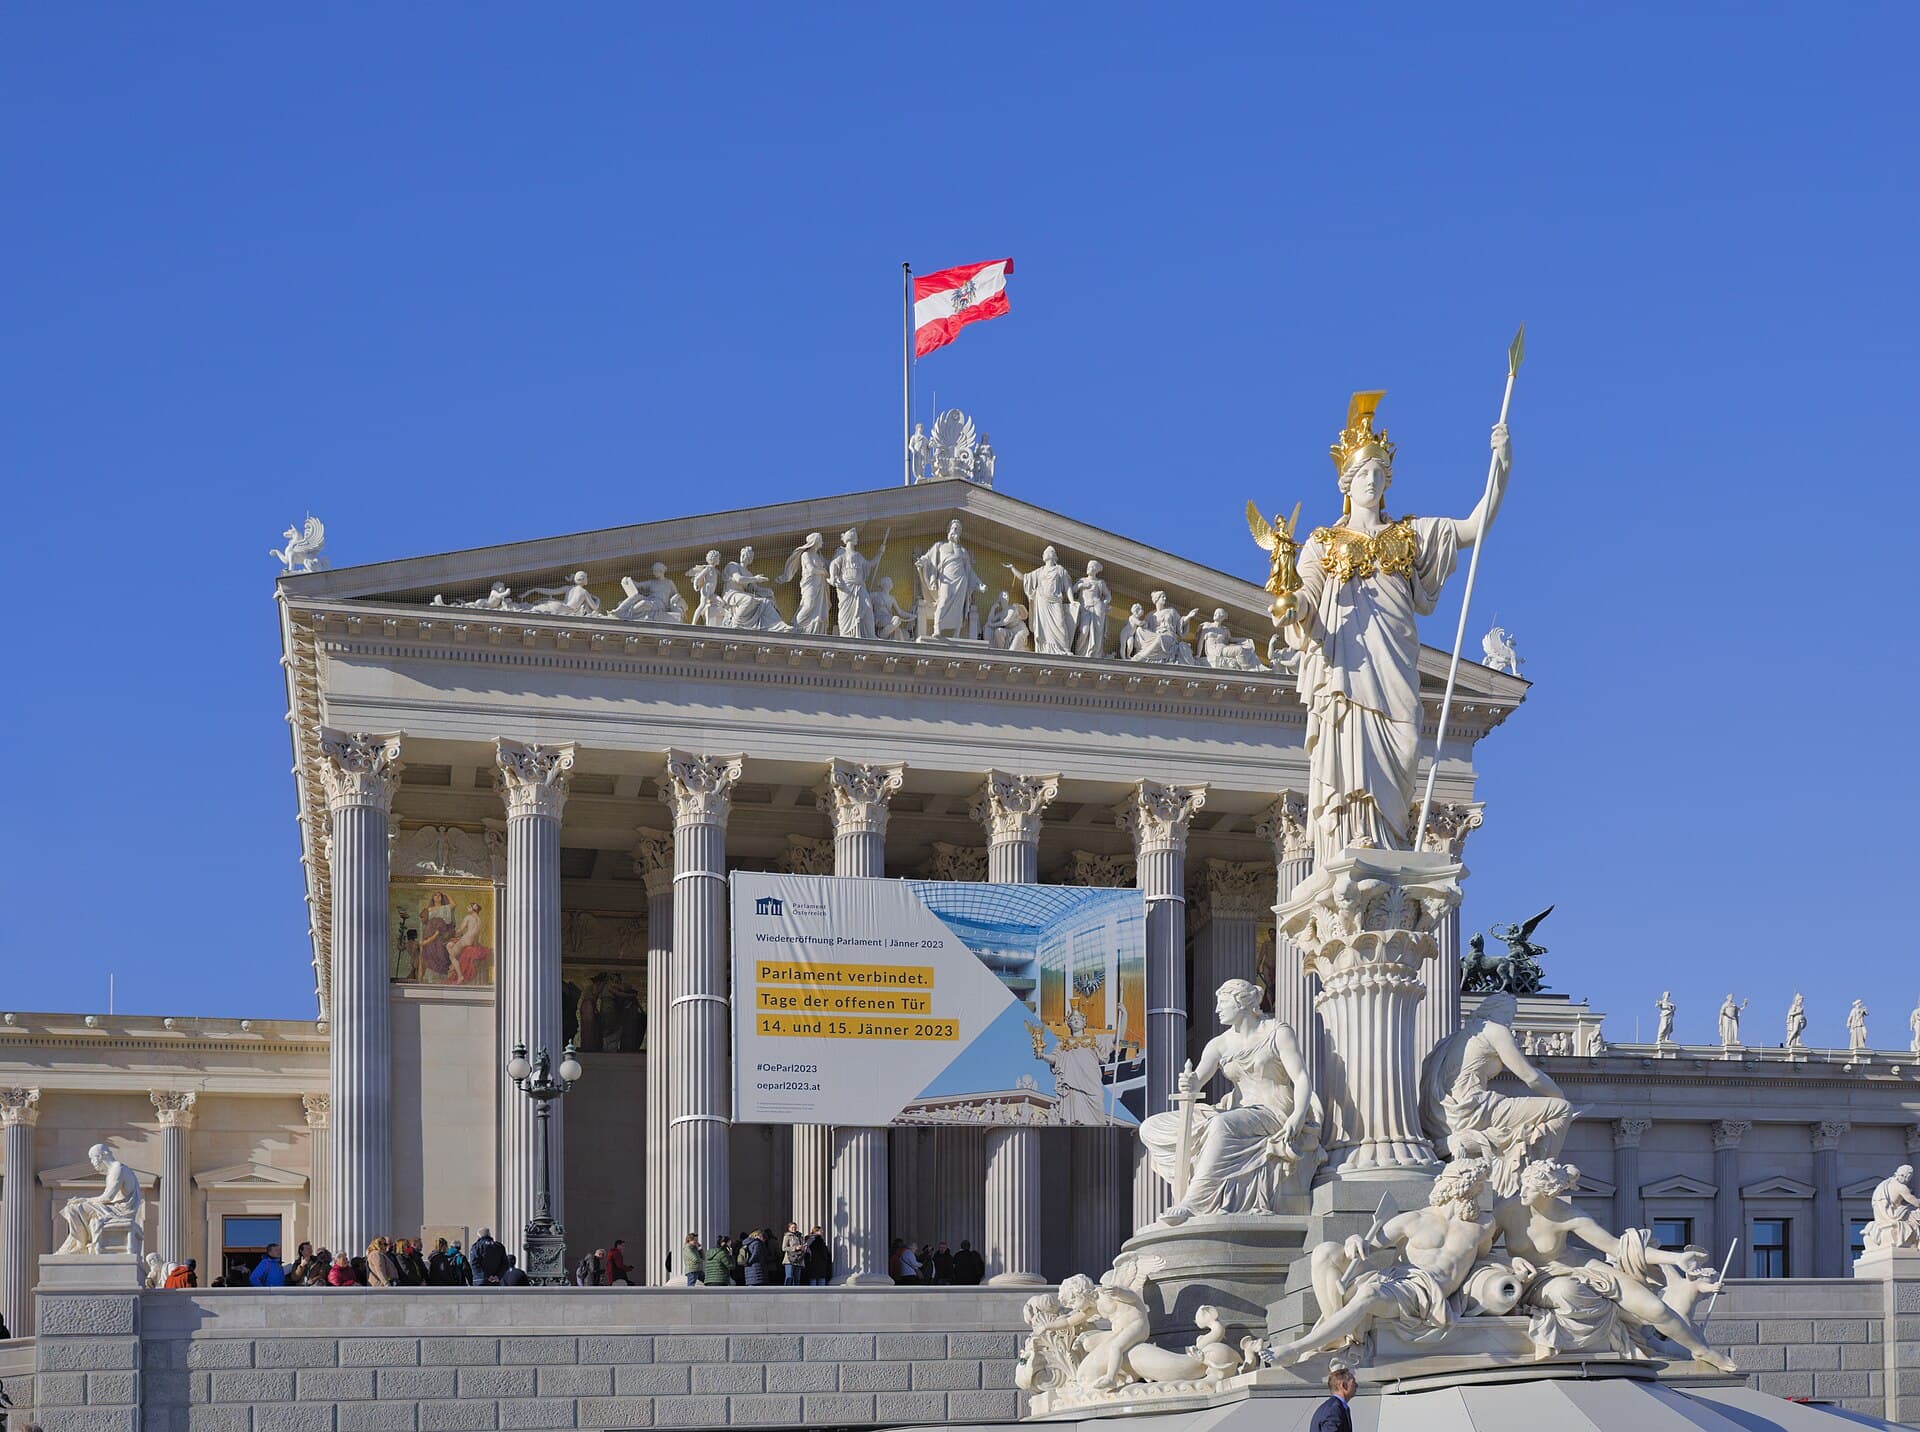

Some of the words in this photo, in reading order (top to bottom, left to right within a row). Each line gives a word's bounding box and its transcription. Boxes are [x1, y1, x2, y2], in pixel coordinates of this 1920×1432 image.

[792, 908, 827, 917] Österreich
[756, 933, 834, 946] Wiedereröffnung
[836, 937, 882, 947] Parlament
[889, 938, 918, 948] Jänner
[921, 940, 944, 949] 2023
[762, 967, 842, 981] Parlament
[848, 970, 928, 985] verbindet.
[761, 993, 797, 1008] Tage
[803, 995, 829, 1008] der
[835, 996, 895, 1010] offenen
[901, 998, 925, 1010] Tür
[762, 1020, 786, 1033] 14.
[793, 1020, 821, 1033] und
[829, 1022, 852, 1035] 15.
[857, 1023, 909, 1036] Jänner
[914, 1025, 953, 1037] 2023
[757, 1063, 818, 1073] #OeParl2023
[757, 1081, 821, 1091] oeparl2023.at
